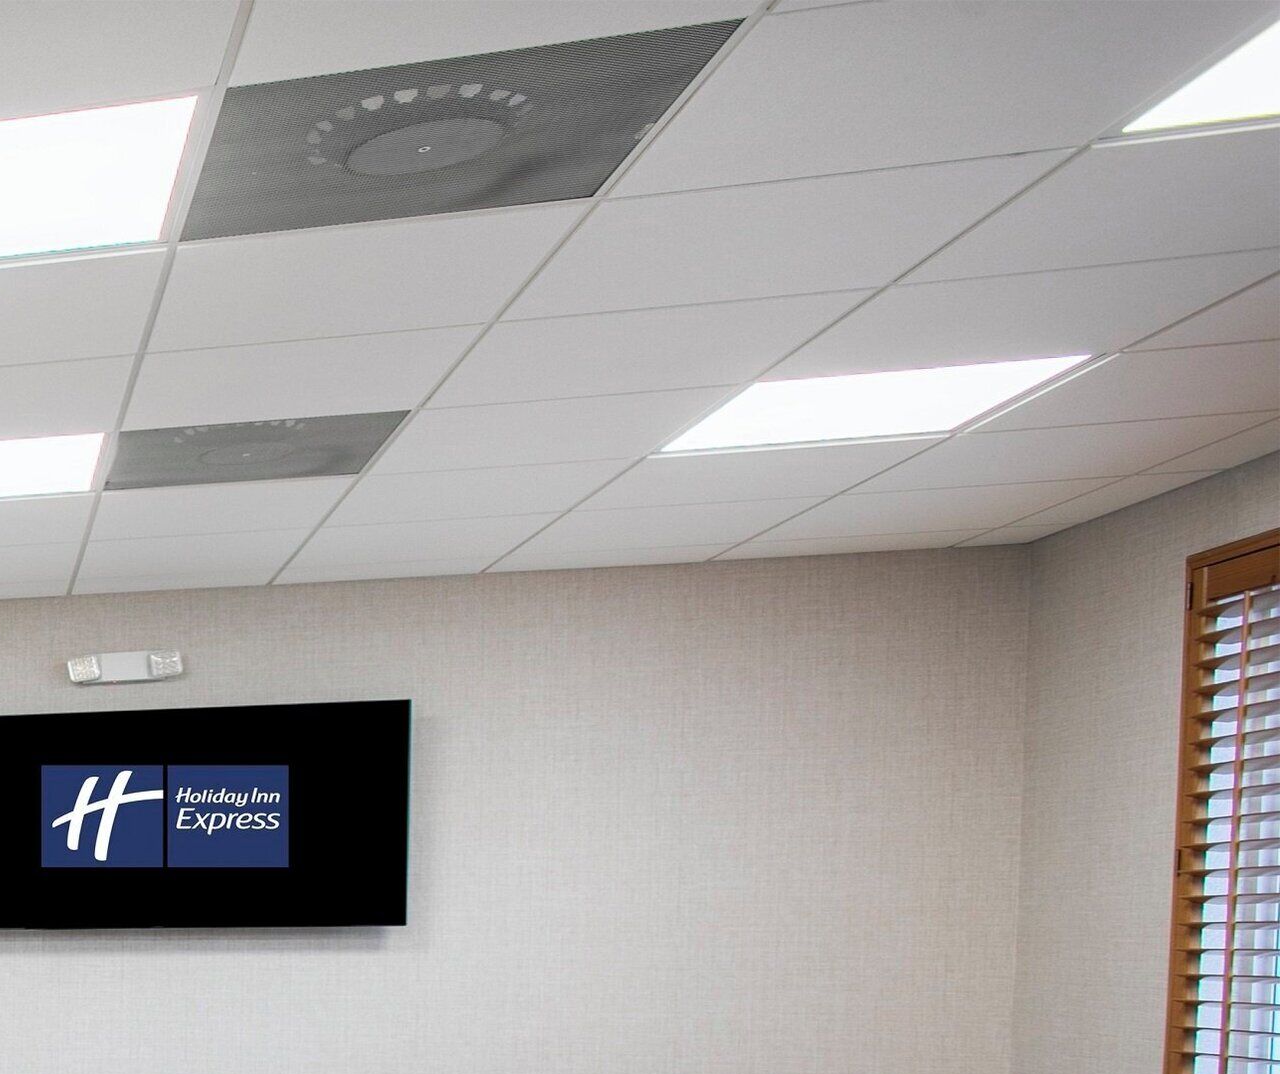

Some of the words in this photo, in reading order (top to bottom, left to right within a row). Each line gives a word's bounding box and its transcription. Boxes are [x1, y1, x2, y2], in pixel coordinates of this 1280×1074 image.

[175, 787, 249, 807] Holiday
[251, 787, 281, 804] Inn
[175, 807, 281, 836] Express
